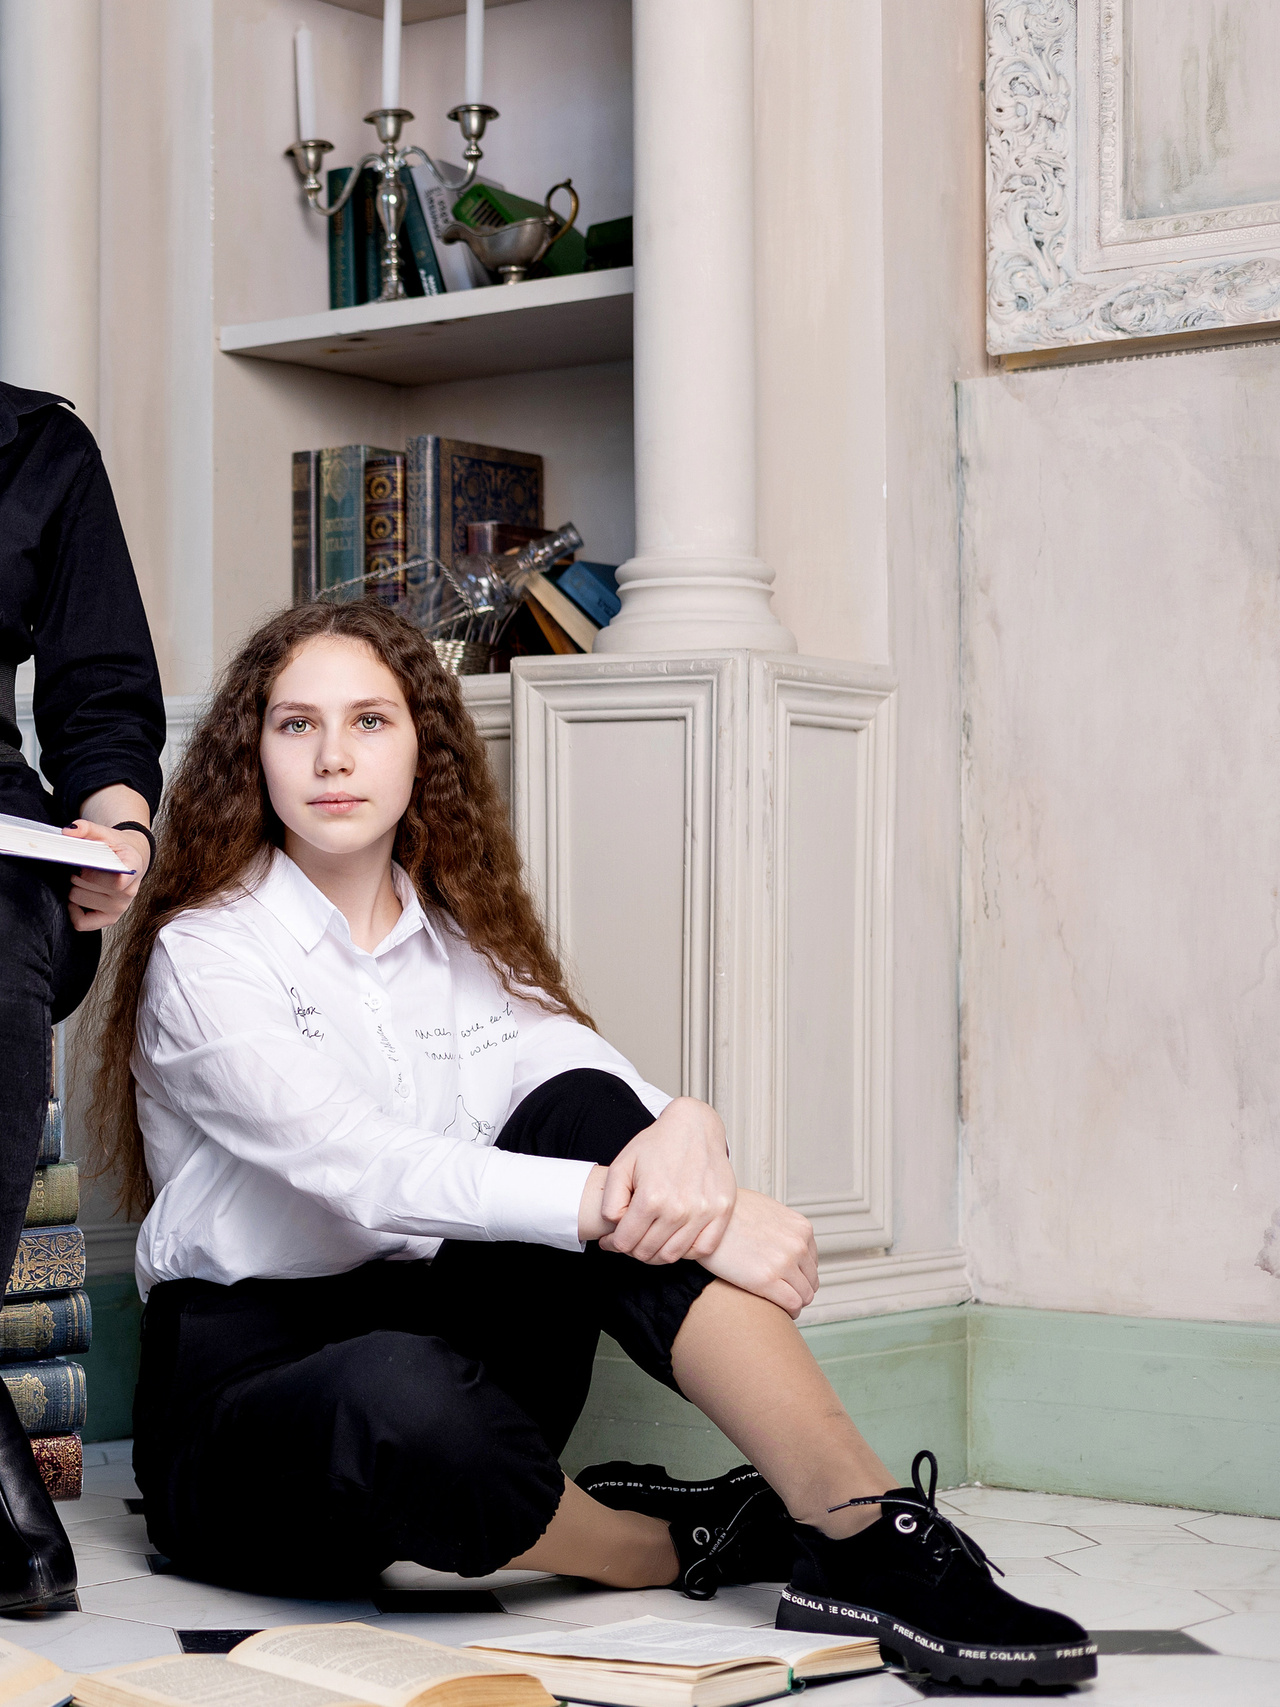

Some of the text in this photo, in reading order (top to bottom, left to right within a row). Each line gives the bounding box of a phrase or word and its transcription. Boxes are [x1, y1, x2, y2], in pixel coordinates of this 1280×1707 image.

[791, 1596, 824, 1611] CQLALA
[840, 1608, 879, 1624] CQLALA
[892, 1623, 945, 1654] FREE CQLALA
[958, 1649, 1037, 1661] FREE CQLALA
[1055, 1647, 1084, 1659] FREE
